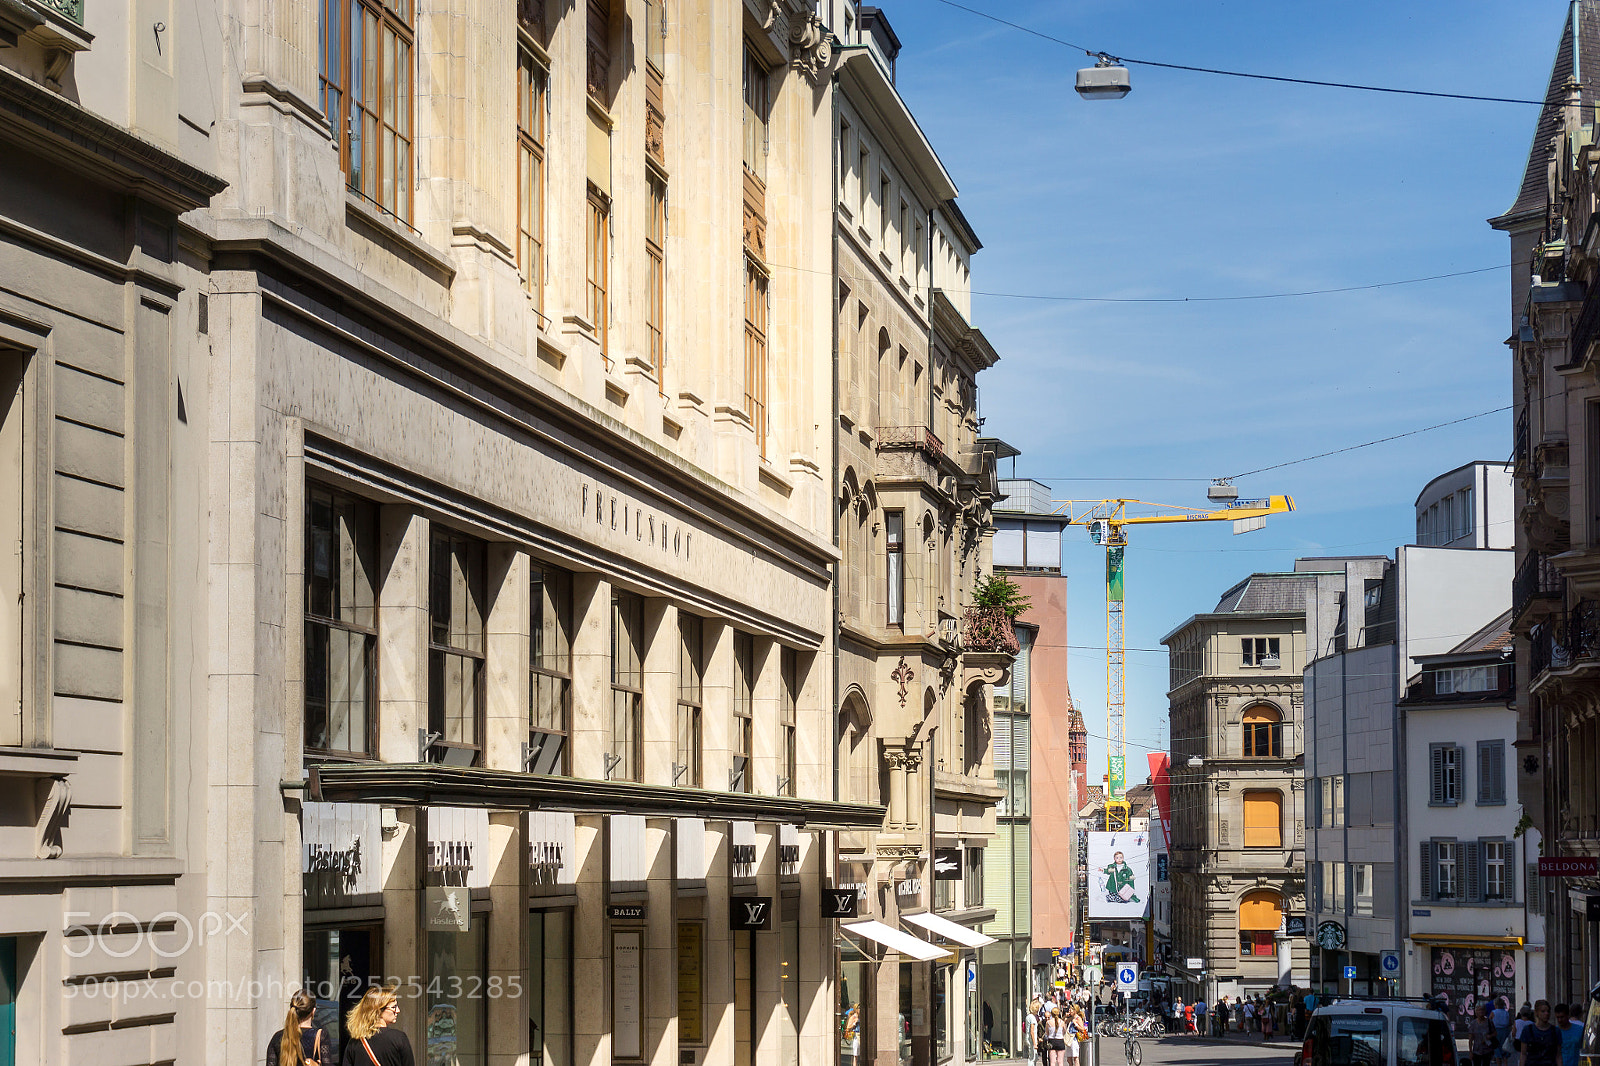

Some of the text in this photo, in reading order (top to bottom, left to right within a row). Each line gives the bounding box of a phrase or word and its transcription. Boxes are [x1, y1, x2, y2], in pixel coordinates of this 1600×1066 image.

[307, 843, 351, 873] Hästens
[433, 841, 474, 867] BALLY
[532, 841, 564, 864] BALLY
[1540, 862, 1595, 871] BELDONA
[613, 908, 641, 916] BALLY
